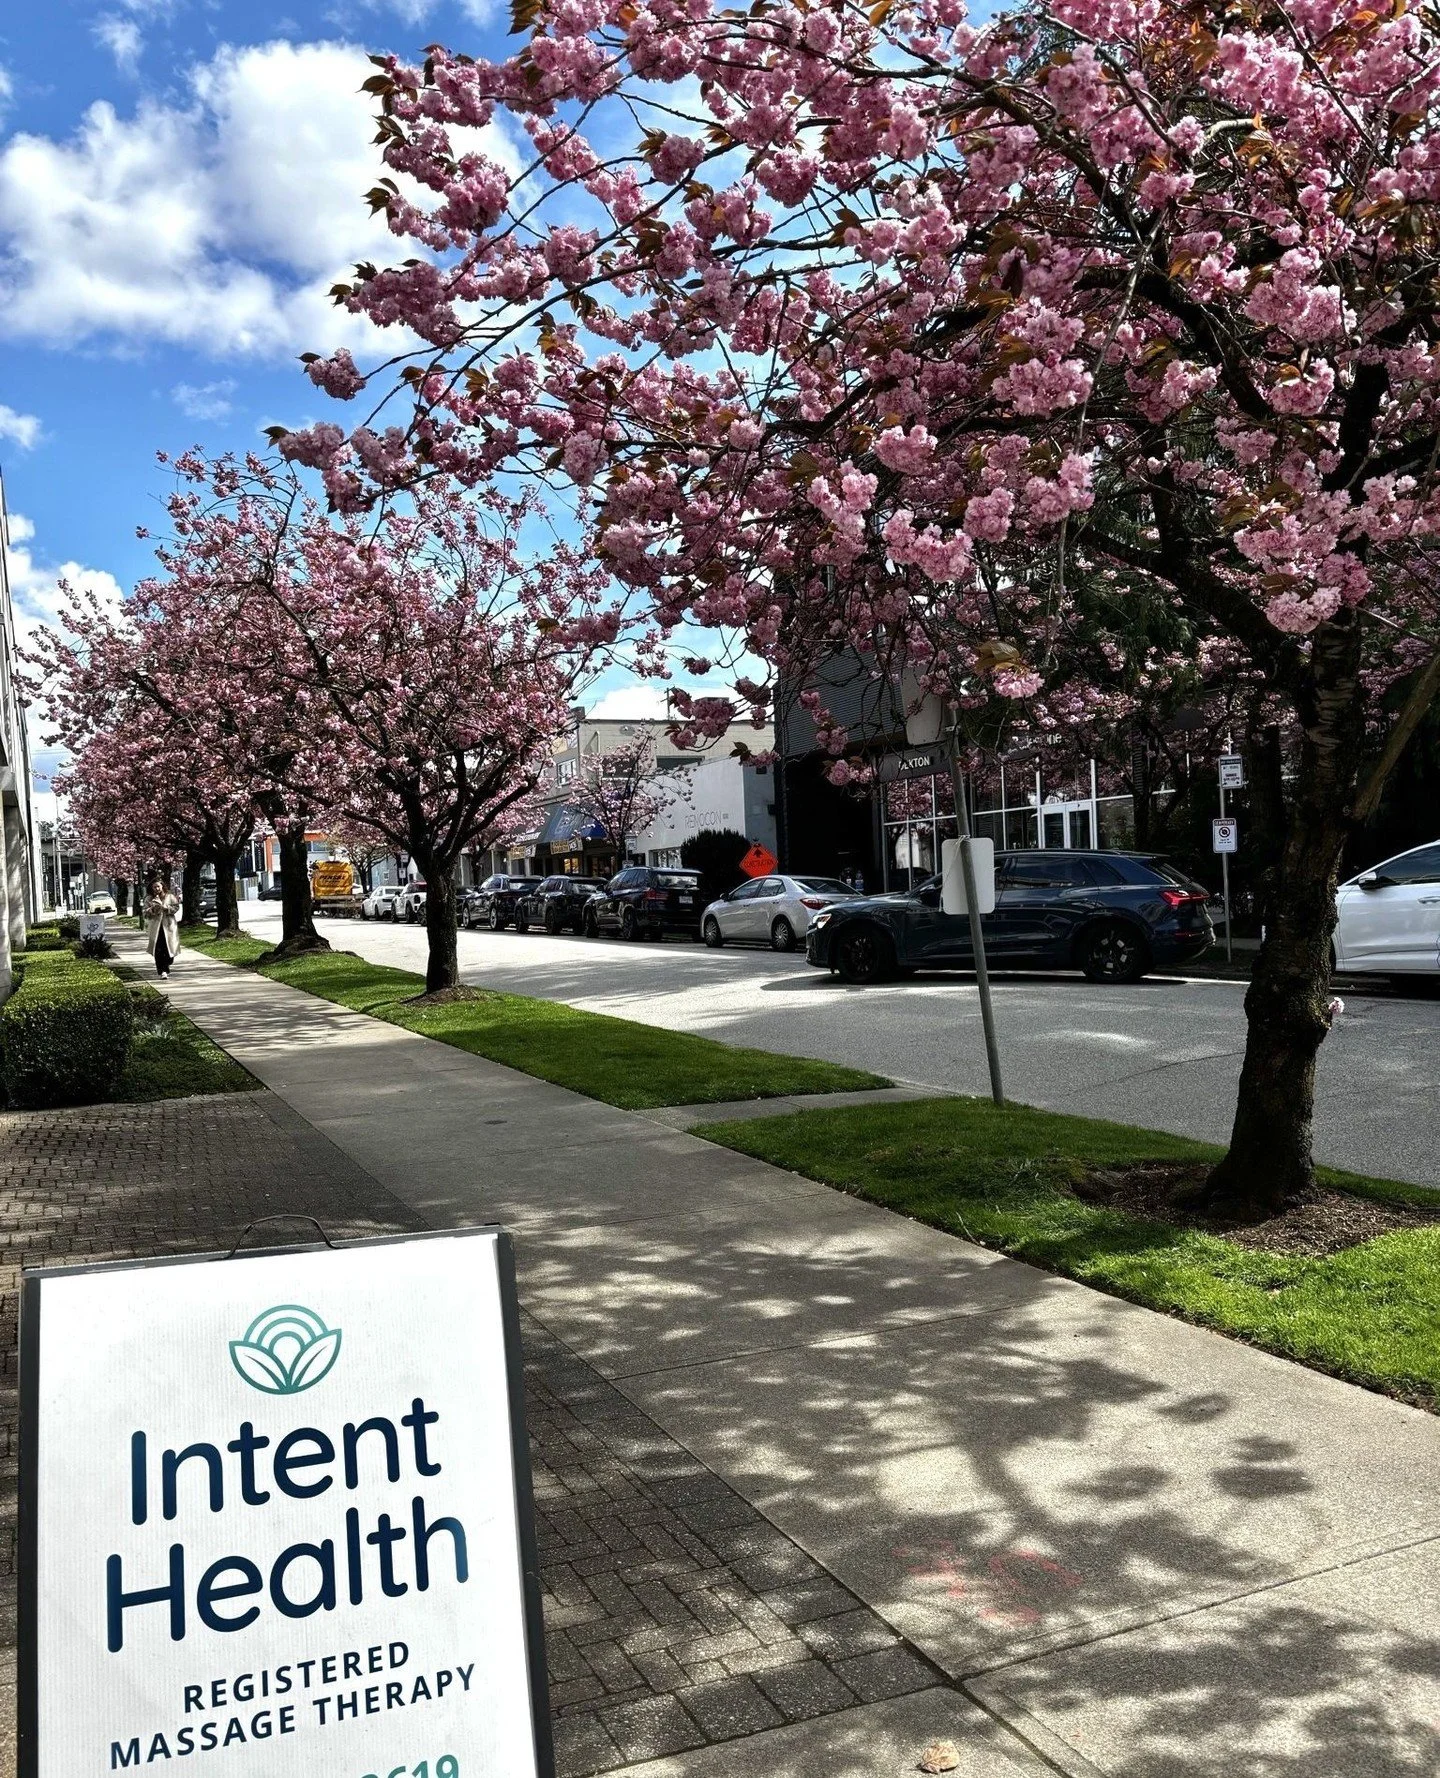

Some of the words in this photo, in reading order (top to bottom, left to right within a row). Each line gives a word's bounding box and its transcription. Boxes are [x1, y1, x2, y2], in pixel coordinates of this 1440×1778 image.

[131, 1396, 442, 1526] Intent
[106, 1495, 469, 1654] Health
[110, 1704, 297, 1770] MASSAGE
[312, 1663, 475, 1726] THERAPY
[184, 1641, 409, 1714] REGISTERED
